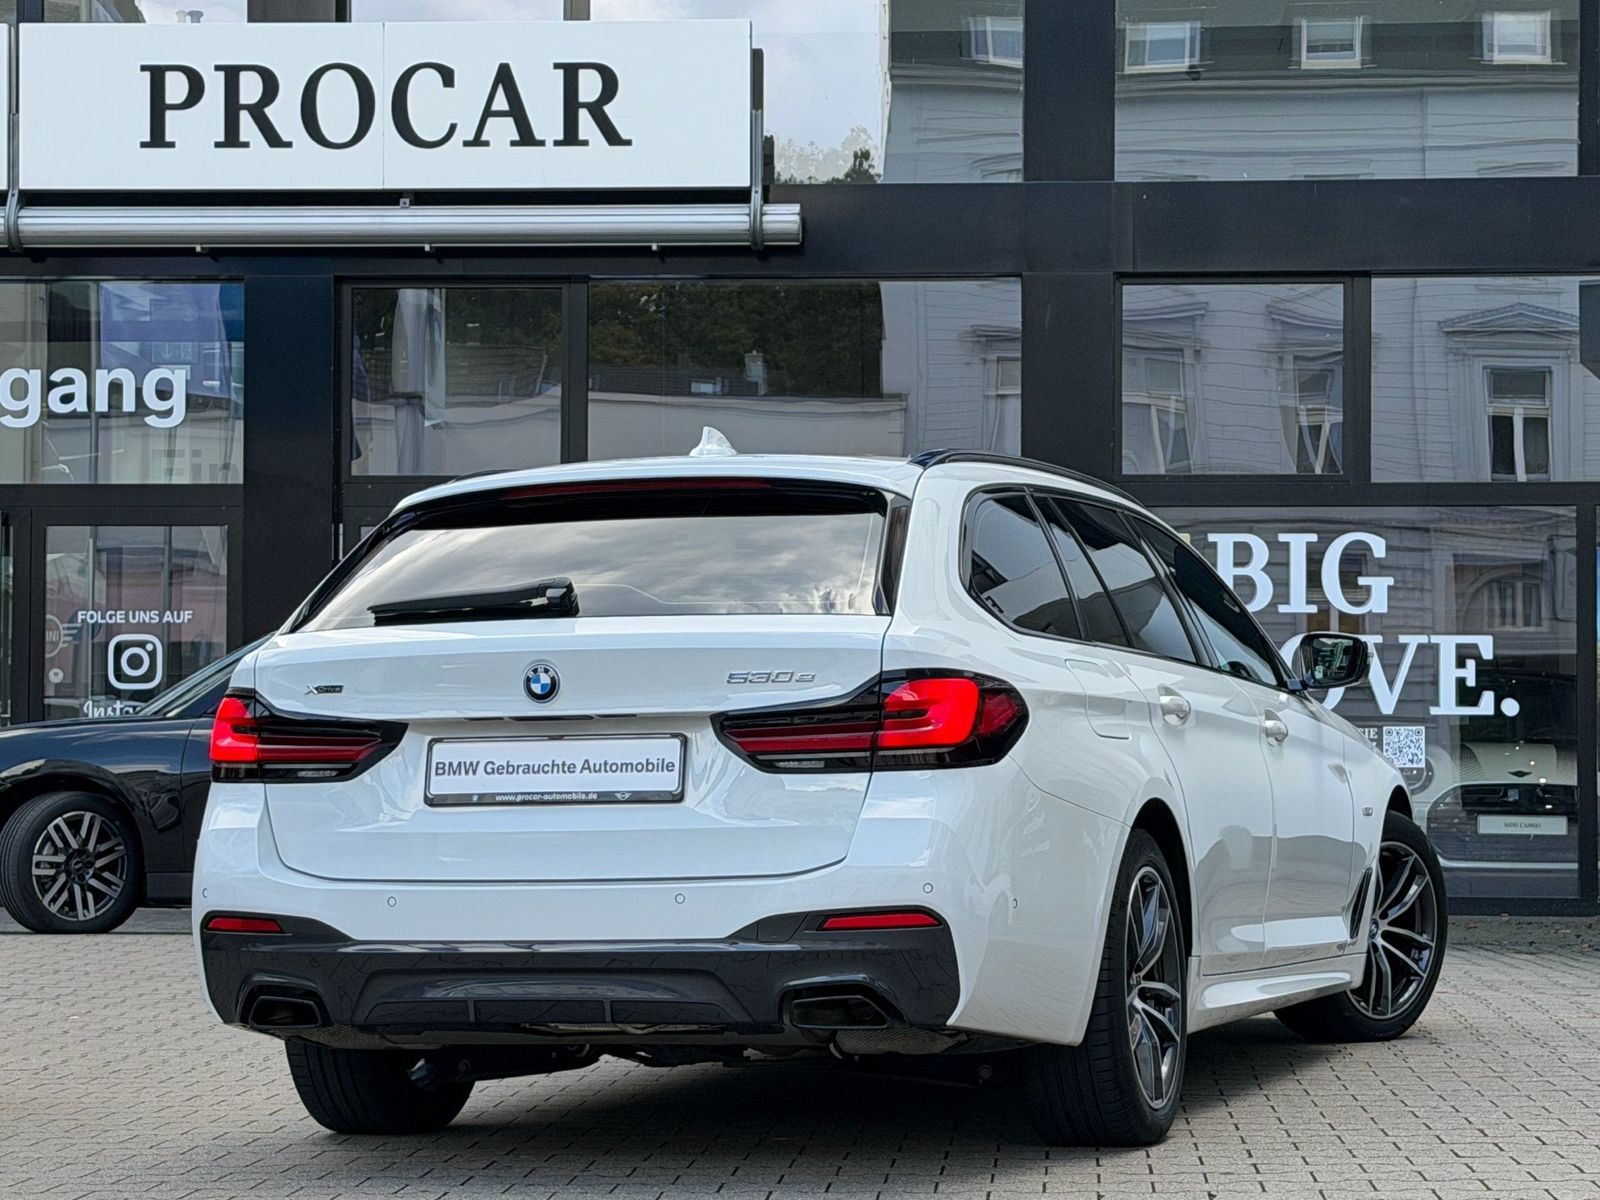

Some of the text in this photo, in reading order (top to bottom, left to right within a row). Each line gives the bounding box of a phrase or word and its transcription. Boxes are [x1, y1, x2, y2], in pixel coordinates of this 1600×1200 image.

[139, 61, 633, 149] PROCAR
[0, 367, 187, 428] gang
[1207, 531, 1394, 615] BIG
[77, 610, 193, 624] FOLGE UNS AUF
[727, 670, 816, 684] 530e
[434, 757, 676, 776] BMW Gebrauchte Automobile
